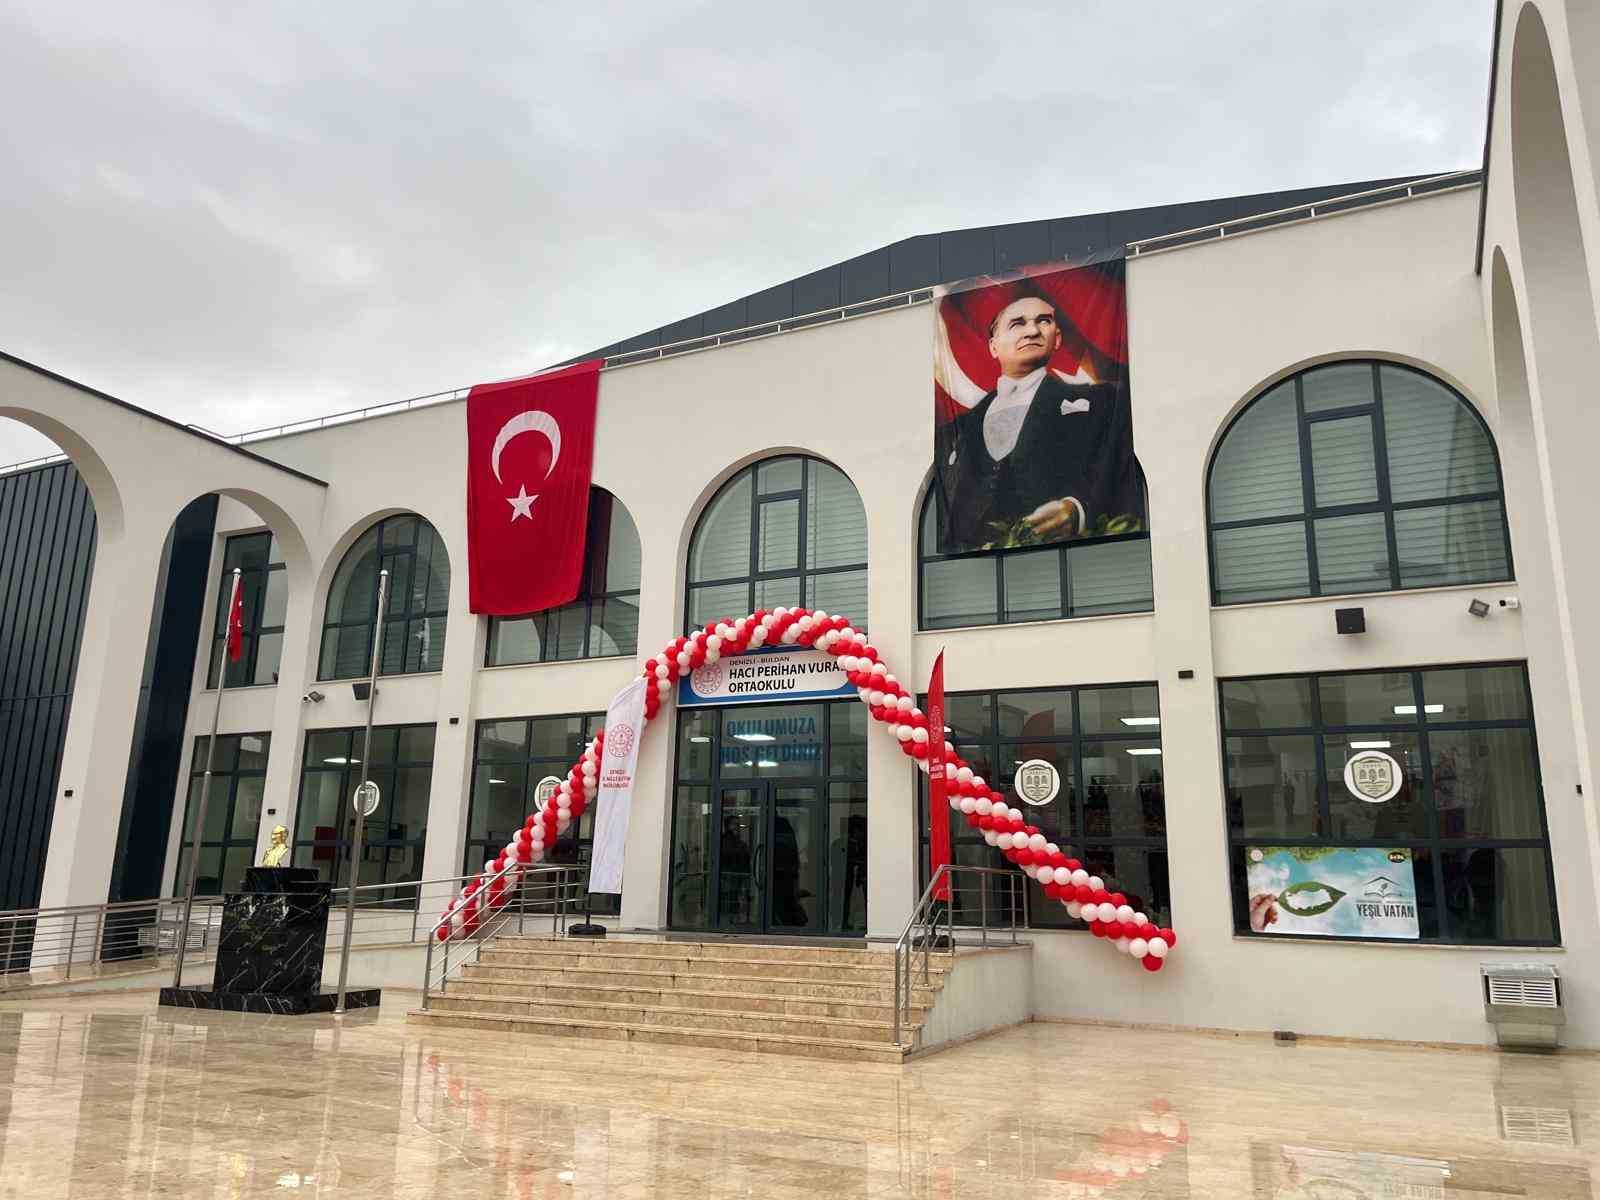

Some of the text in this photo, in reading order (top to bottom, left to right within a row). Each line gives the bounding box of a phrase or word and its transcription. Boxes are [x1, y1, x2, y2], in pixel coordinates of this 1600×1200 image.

[761, 656, 790, 664] BULDAN
[729, 661, 847, 680] HACI PERİHAN VURA
[728, 678, 795, 693] ORTAOKULU
[727, 717, 816, 737] OKULUMUZA
[1383, 904, 1414, 918] VATAN
